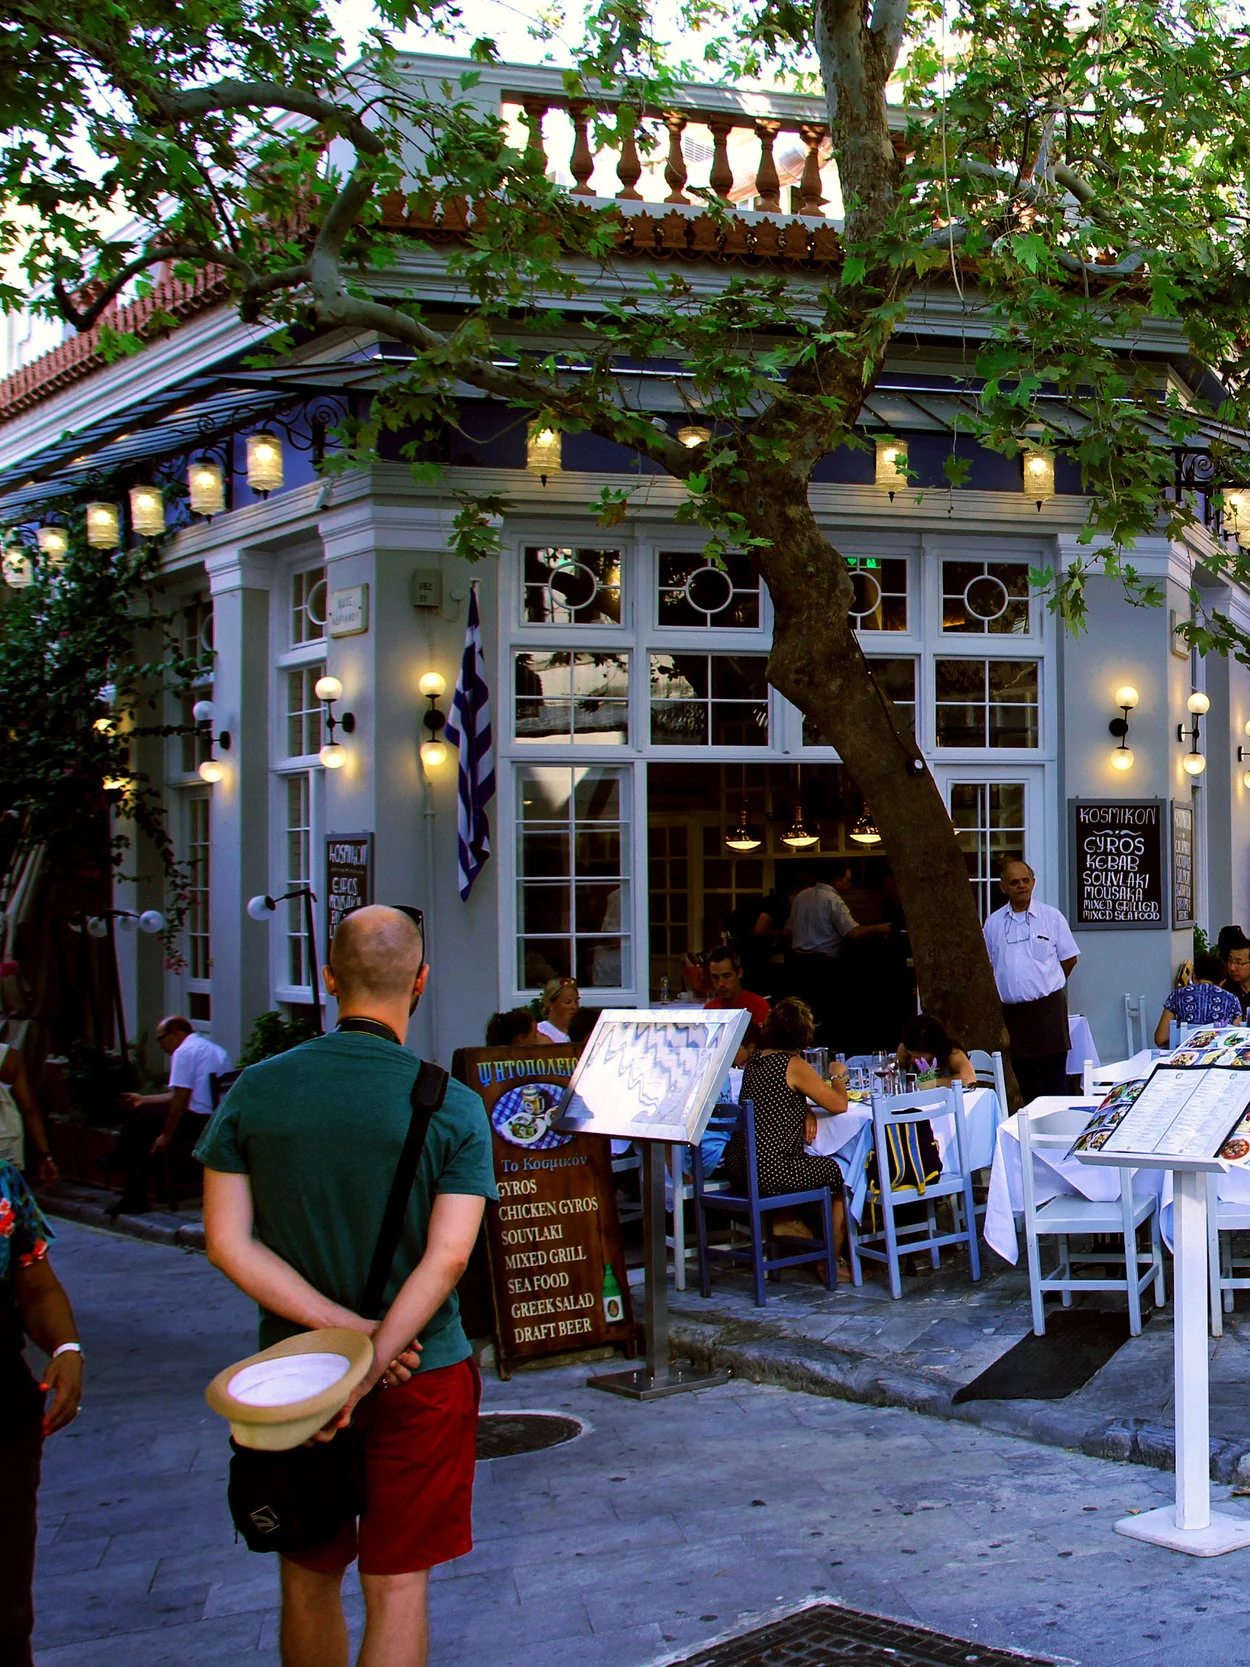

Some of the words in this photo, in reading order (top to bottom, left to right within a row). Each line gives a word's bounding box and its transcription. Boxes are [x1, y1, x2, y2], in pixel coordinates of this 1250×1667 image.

[1080, 807, 1156, 825] KOSMIKON
[1083, 836, 1145, 855] GYROS
[1086, 855, 1139, 872] KEBAB
[1082, 870, 1149, 889] SOUVLAKI
[1084, 886, 1143, 902] MOUSAKA
[1082, 910, 1113, 920] MIXED
[1083, 899, 1113, 910] MIXED
[1115, 900, 1159, 912] GRILLED
[501, 1159, 519, 1173] Το
[496, 1179, 538, 1198] GYROS
[498, 1200, 557, 1221] CHICKEN
[558, 1196, 599, 1215] GYROS
[501, 1224, 564, 1246] SOUVLAKI
[505, 1250, 548, 1270] MIXED
[549, 1246, 587, 1264] GRILL
[507, 1278, 533, 1295] SEA
[533, 1272, 570, 1291] FOOD
[511, 1298, 556, 1319] GREEK
[555, 1292, 595, 1312] SALAD
[513, 1323, 558, 1344] DRAFT
[558, 1317, 593, 1337] BEER
